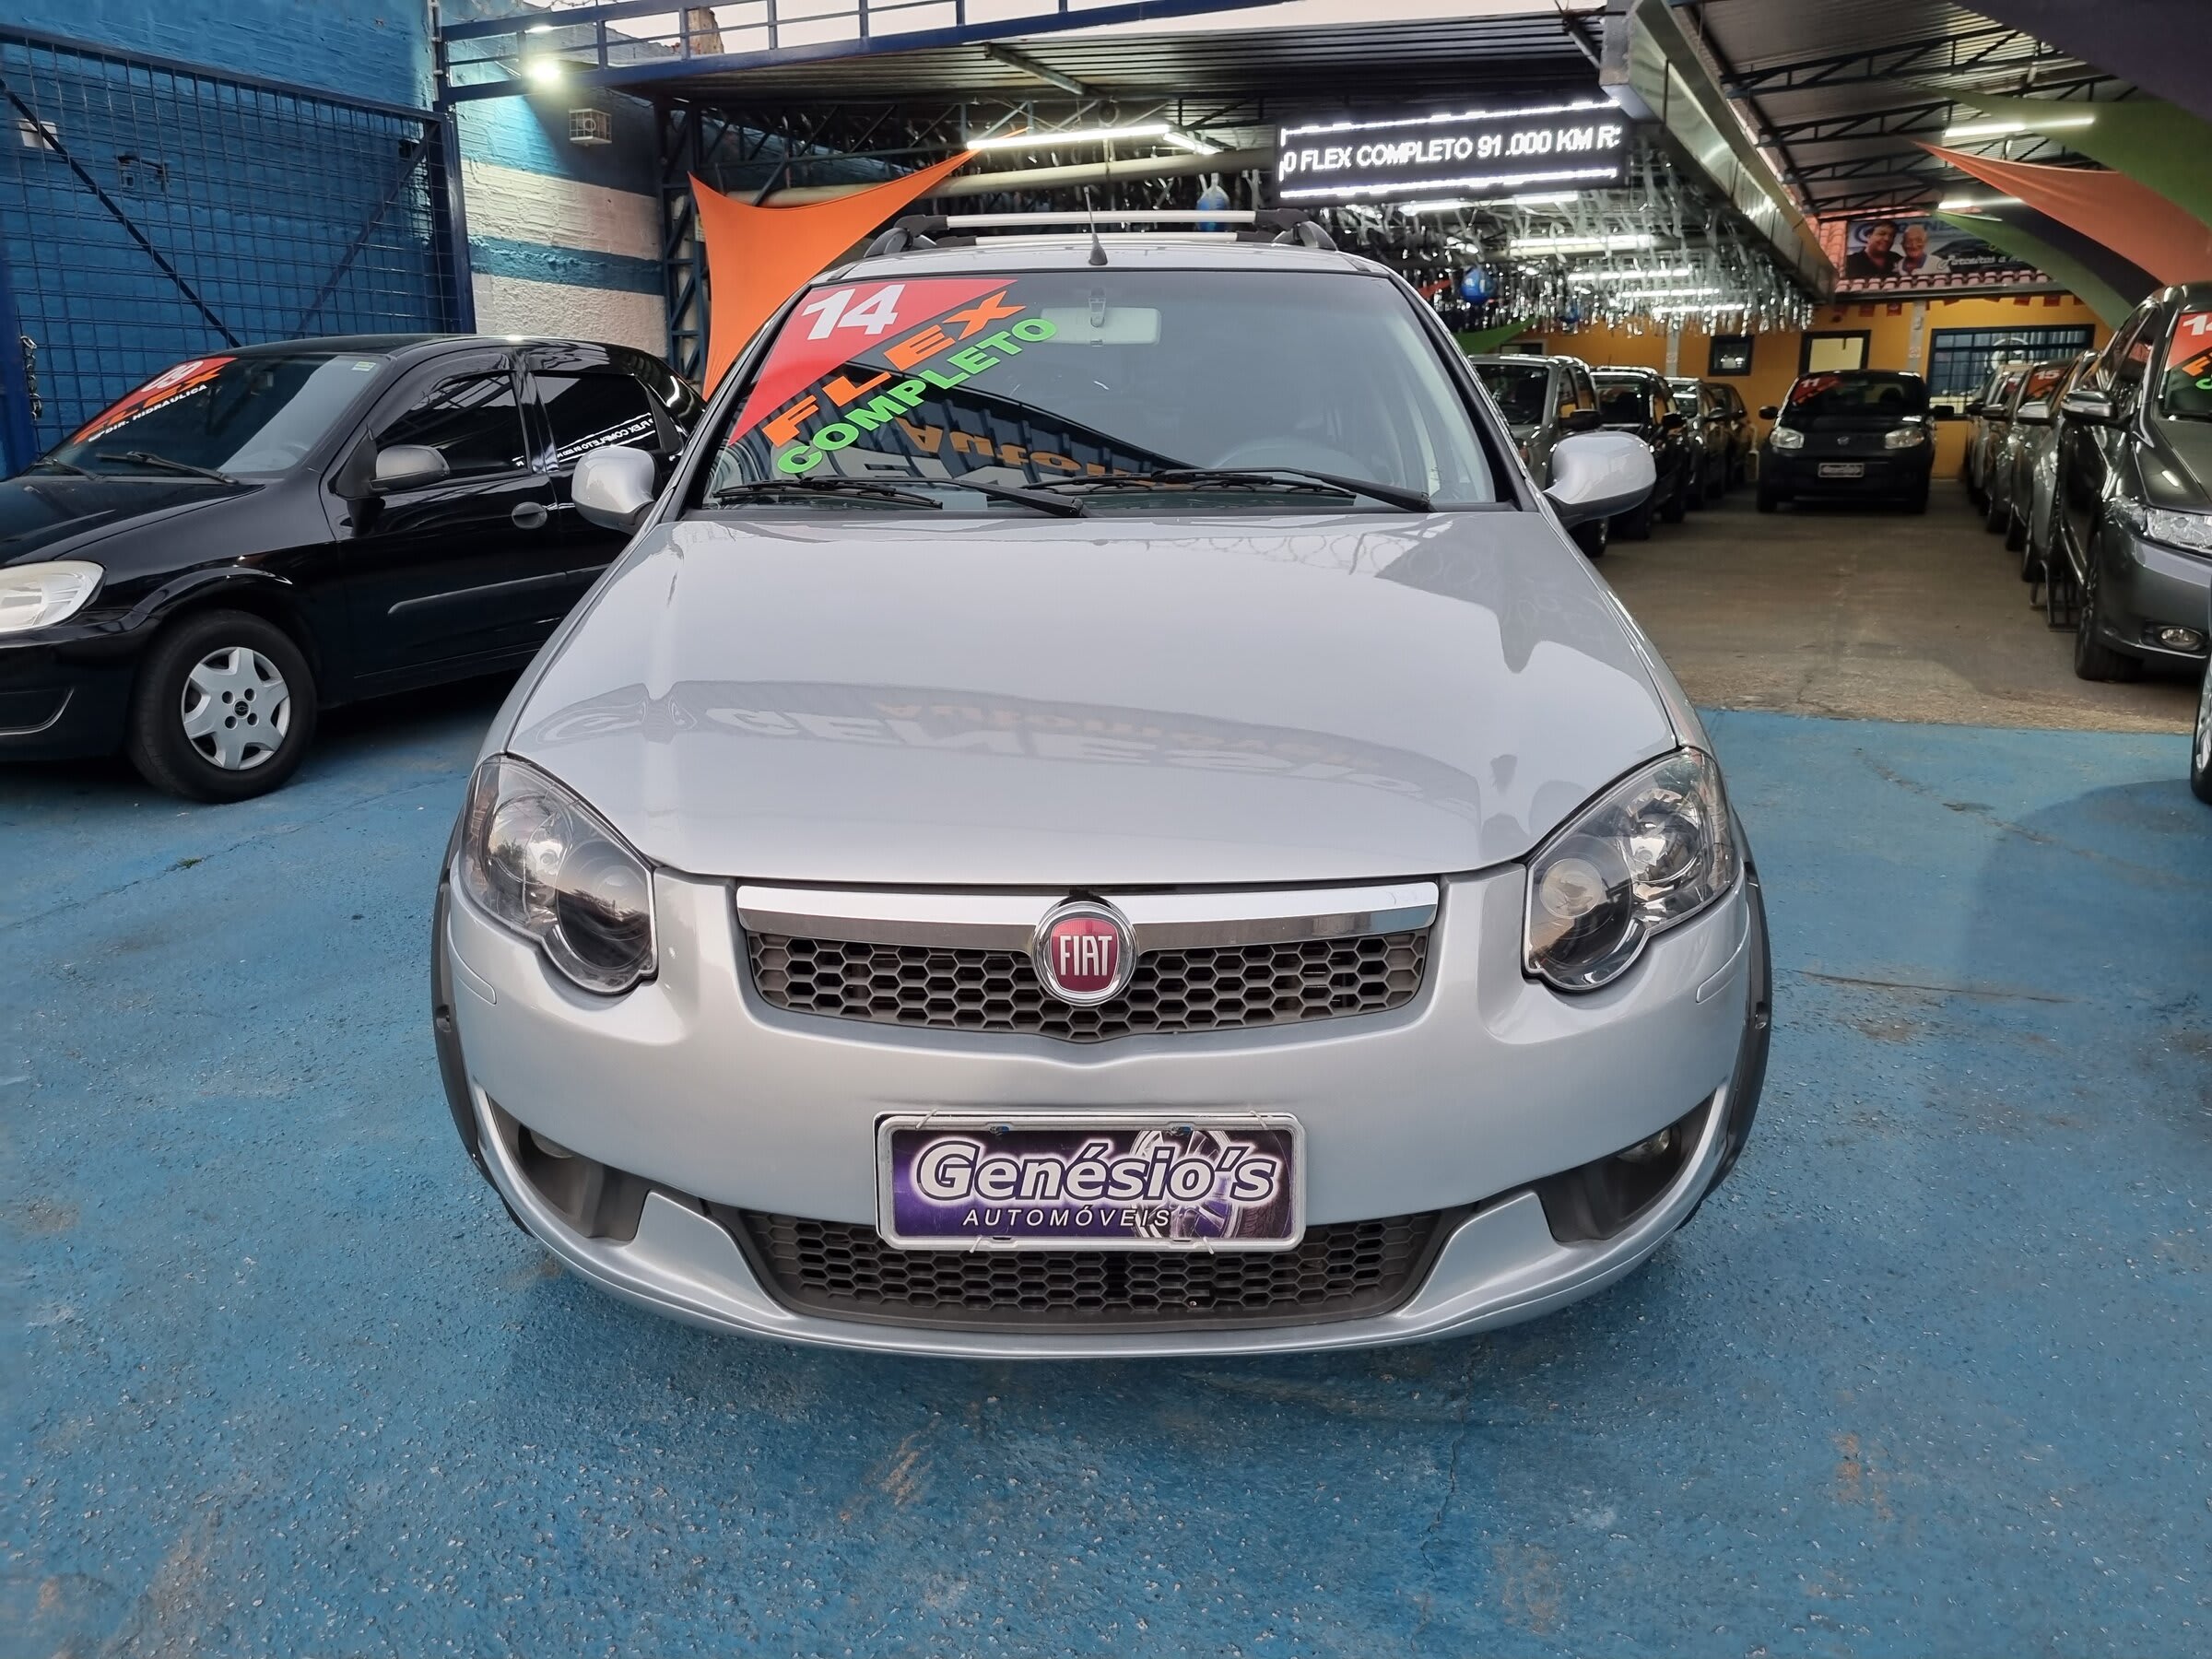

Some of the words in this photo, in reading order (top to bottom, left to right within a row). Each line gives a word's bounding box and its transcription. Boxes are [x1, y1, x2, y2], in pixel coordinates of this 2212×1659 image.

[1300, 147, 1353, 171] FLEX
[1357, 137, 1473, 166] COMPLETO
[1556, 125, 1594, 152] KM
[802, 284, 906, 341] 14
[761, 290, 1026, 448] FLEX
[777, 318, 1057, 475] COMPLETO
[1060, 935, 1112, 976] FIAT
[916, 1140, 1278, 1202] Genésio's
[962, 1206, 1171, 1228] AUTOMÓVEIS
